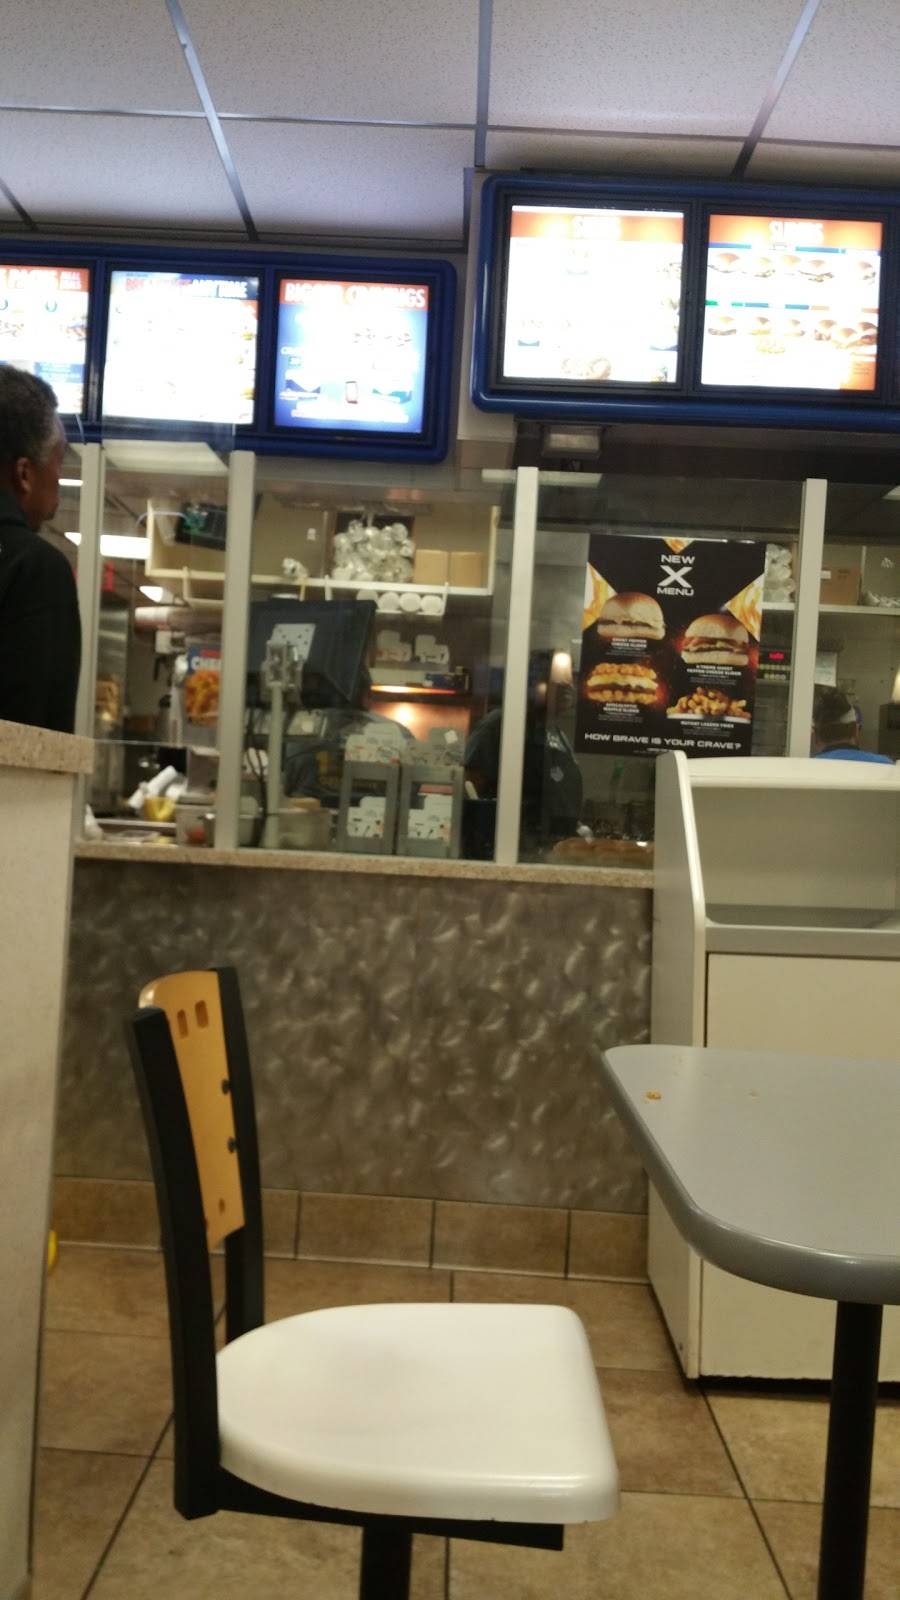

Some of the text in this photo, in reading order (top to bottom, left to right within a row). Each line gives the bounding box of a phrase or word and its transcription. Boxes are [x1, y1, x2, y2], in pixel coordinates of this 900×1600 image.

[661, 554, 696, 564] NEW
[657, 565, 693, 588] X
[656, 587, 695, 597] MENU
[584, 732, 742, 750] HOW BRAVE IS YOUR CRAVE?
